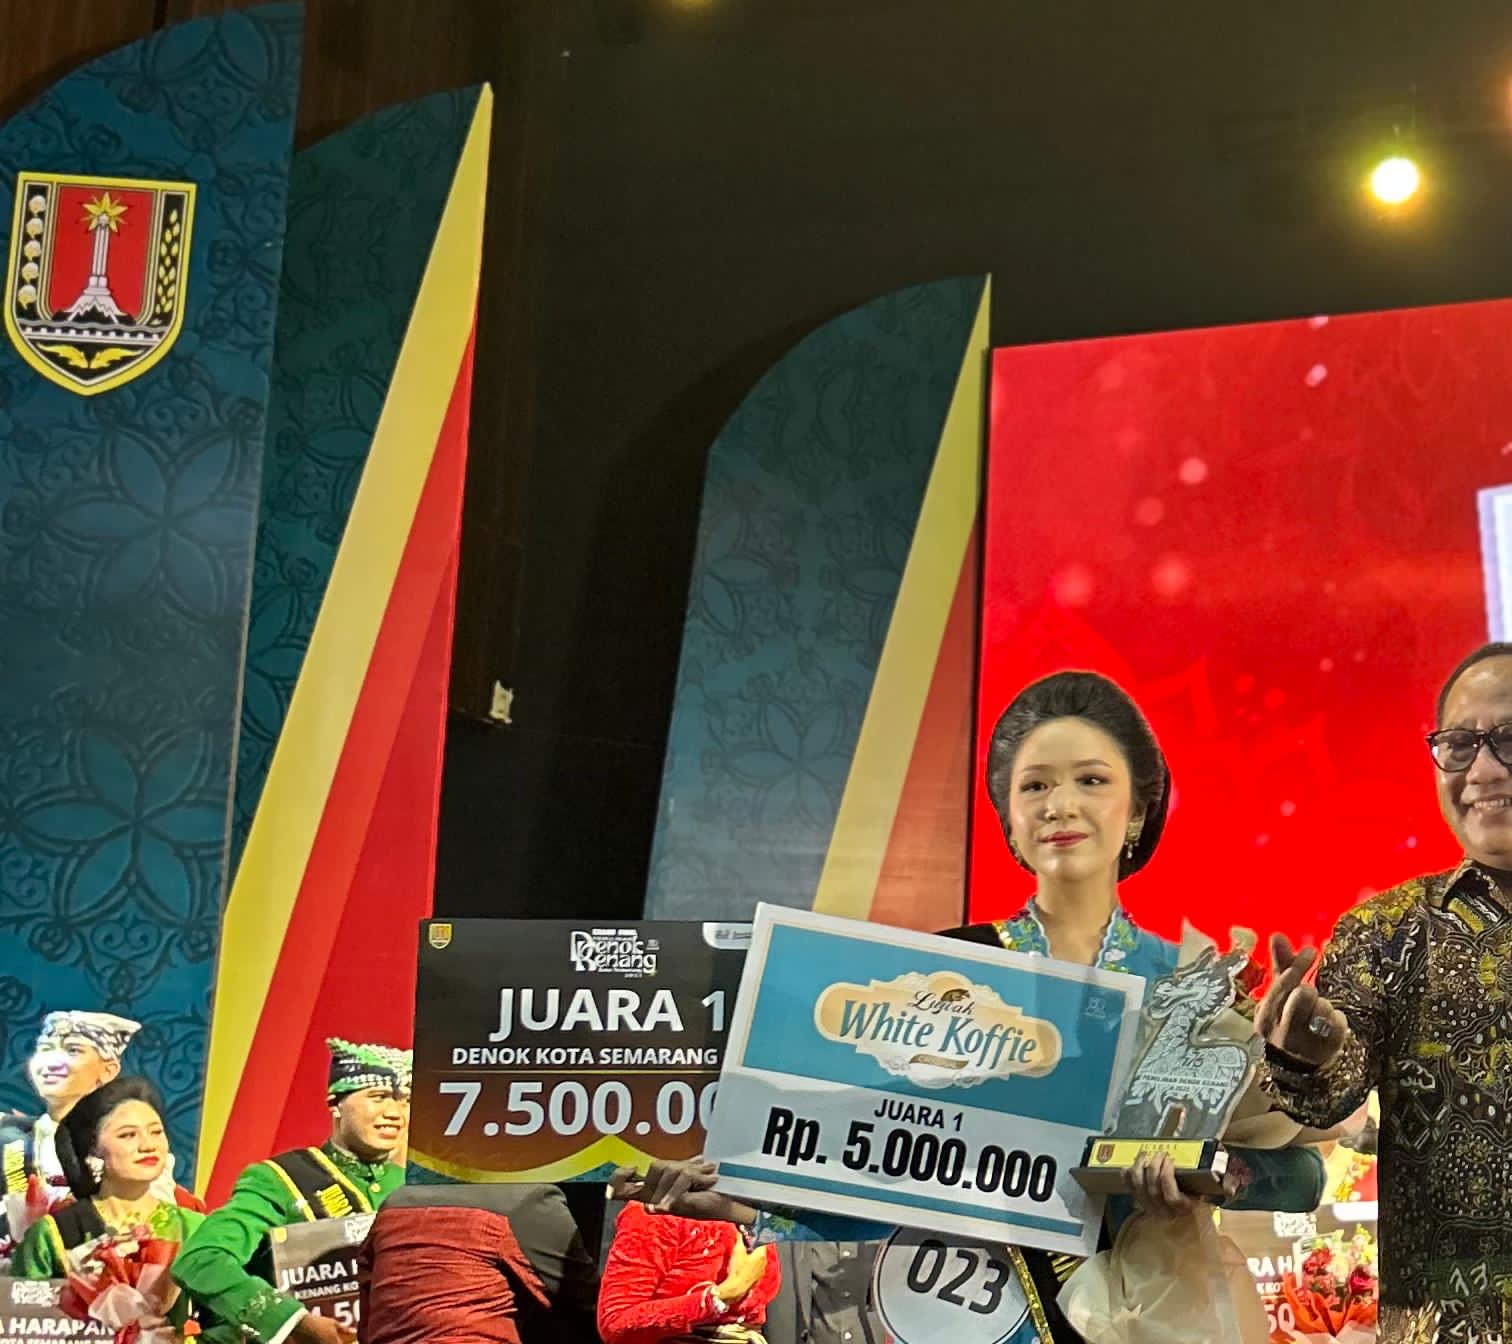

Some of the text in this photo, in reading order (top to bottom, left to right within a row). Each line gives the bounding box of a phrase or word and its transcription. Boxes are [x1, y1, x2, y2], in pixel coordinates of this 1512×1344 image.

[489, 988, 726, 1042] JUARA 1
[839, 999, 1037, 1070] White Koffie
[452, 1047, 718, 1065] DENOK KOTA SEMARANG
[439, 1080, 720, 1137] 7.500.0
[874, 1098, 965, 1132] JUARA 1
[761, 1106, 1058, 1203] Rp. 5.000.000
[280, 1261, 344, 1293] JUARA
[907, 1239, 1010, 1315] 023
